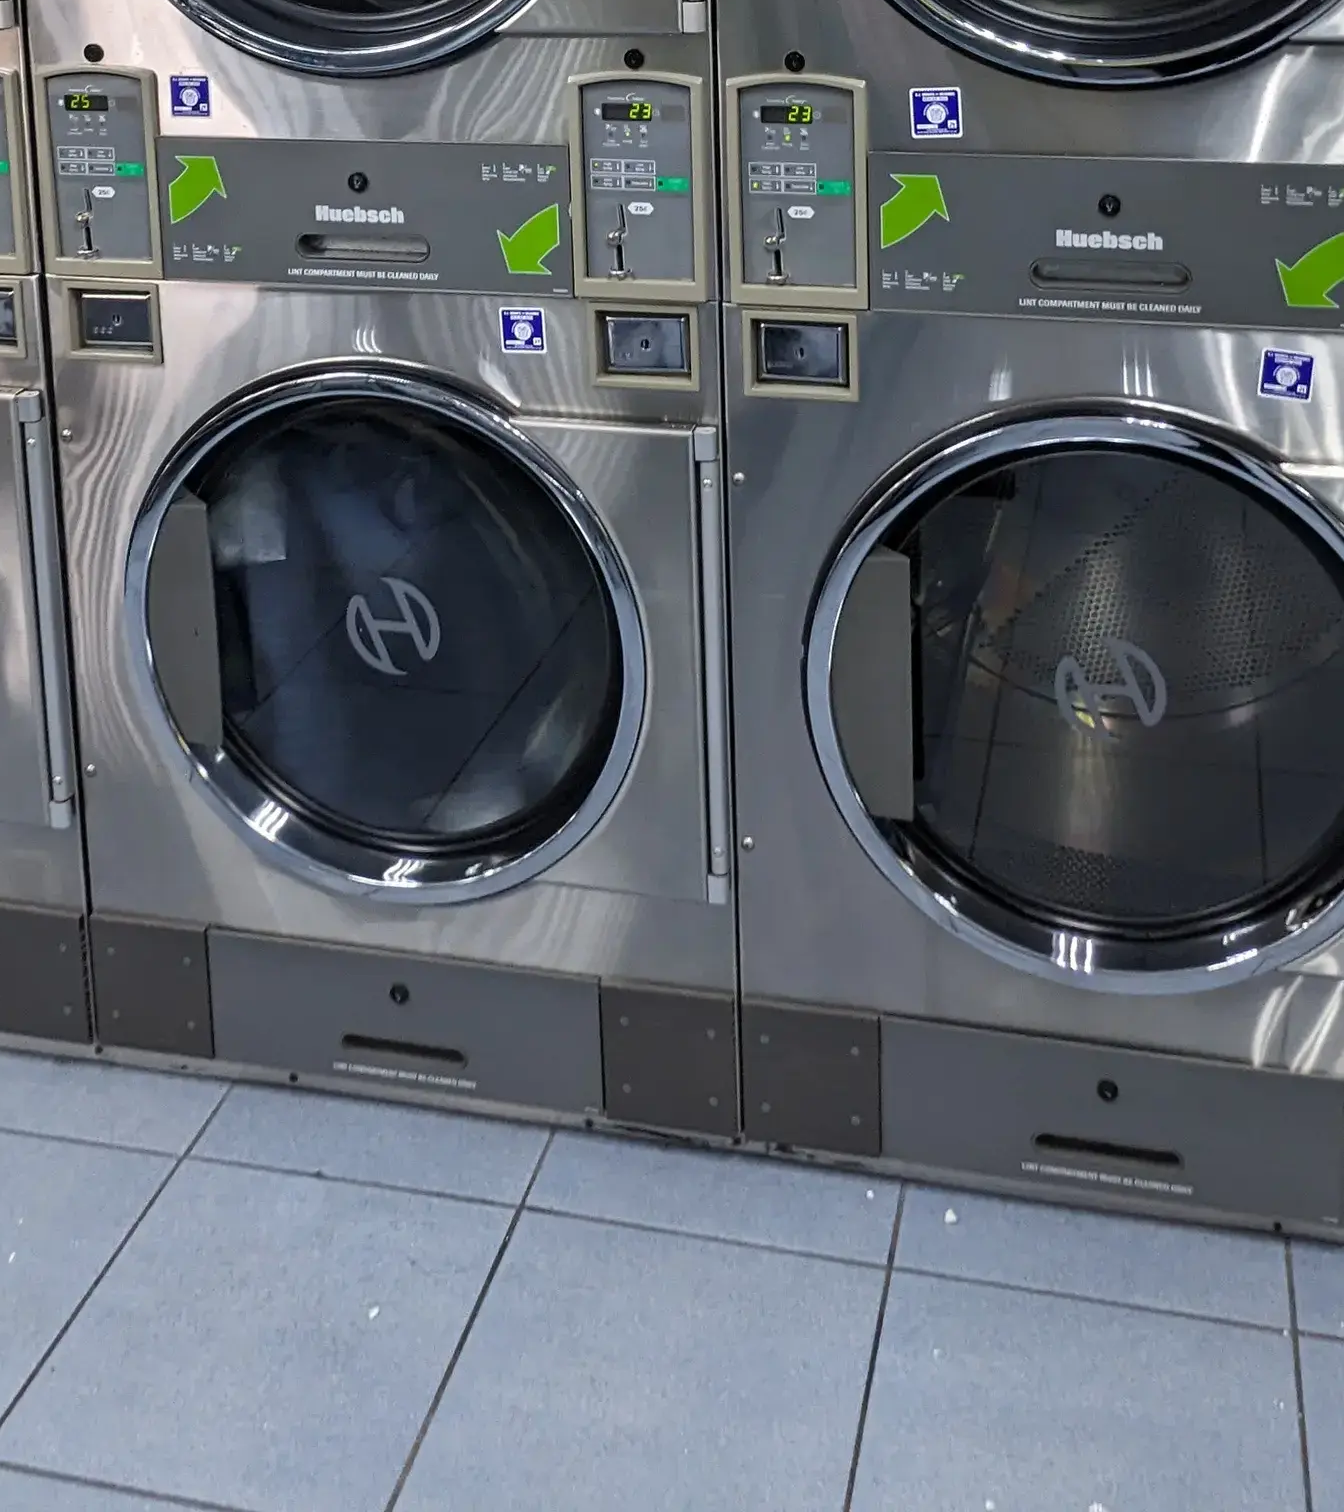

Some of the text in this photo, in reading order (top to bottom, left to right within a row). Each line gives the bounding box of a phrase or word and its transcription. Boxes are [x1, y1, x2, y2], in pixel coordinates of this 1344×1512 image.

[70, 94, 91, 109] 25
[629, 103, 652, 120] 23
[788, 105, 812, 123] 23
[315, 204, 405, 224] Huebsch
[1055, 229, 1164, 251] Huebsch
[1019, 298, 1202, 314] LINT COMPARTMENT MUST BE CLEANED DAILY
